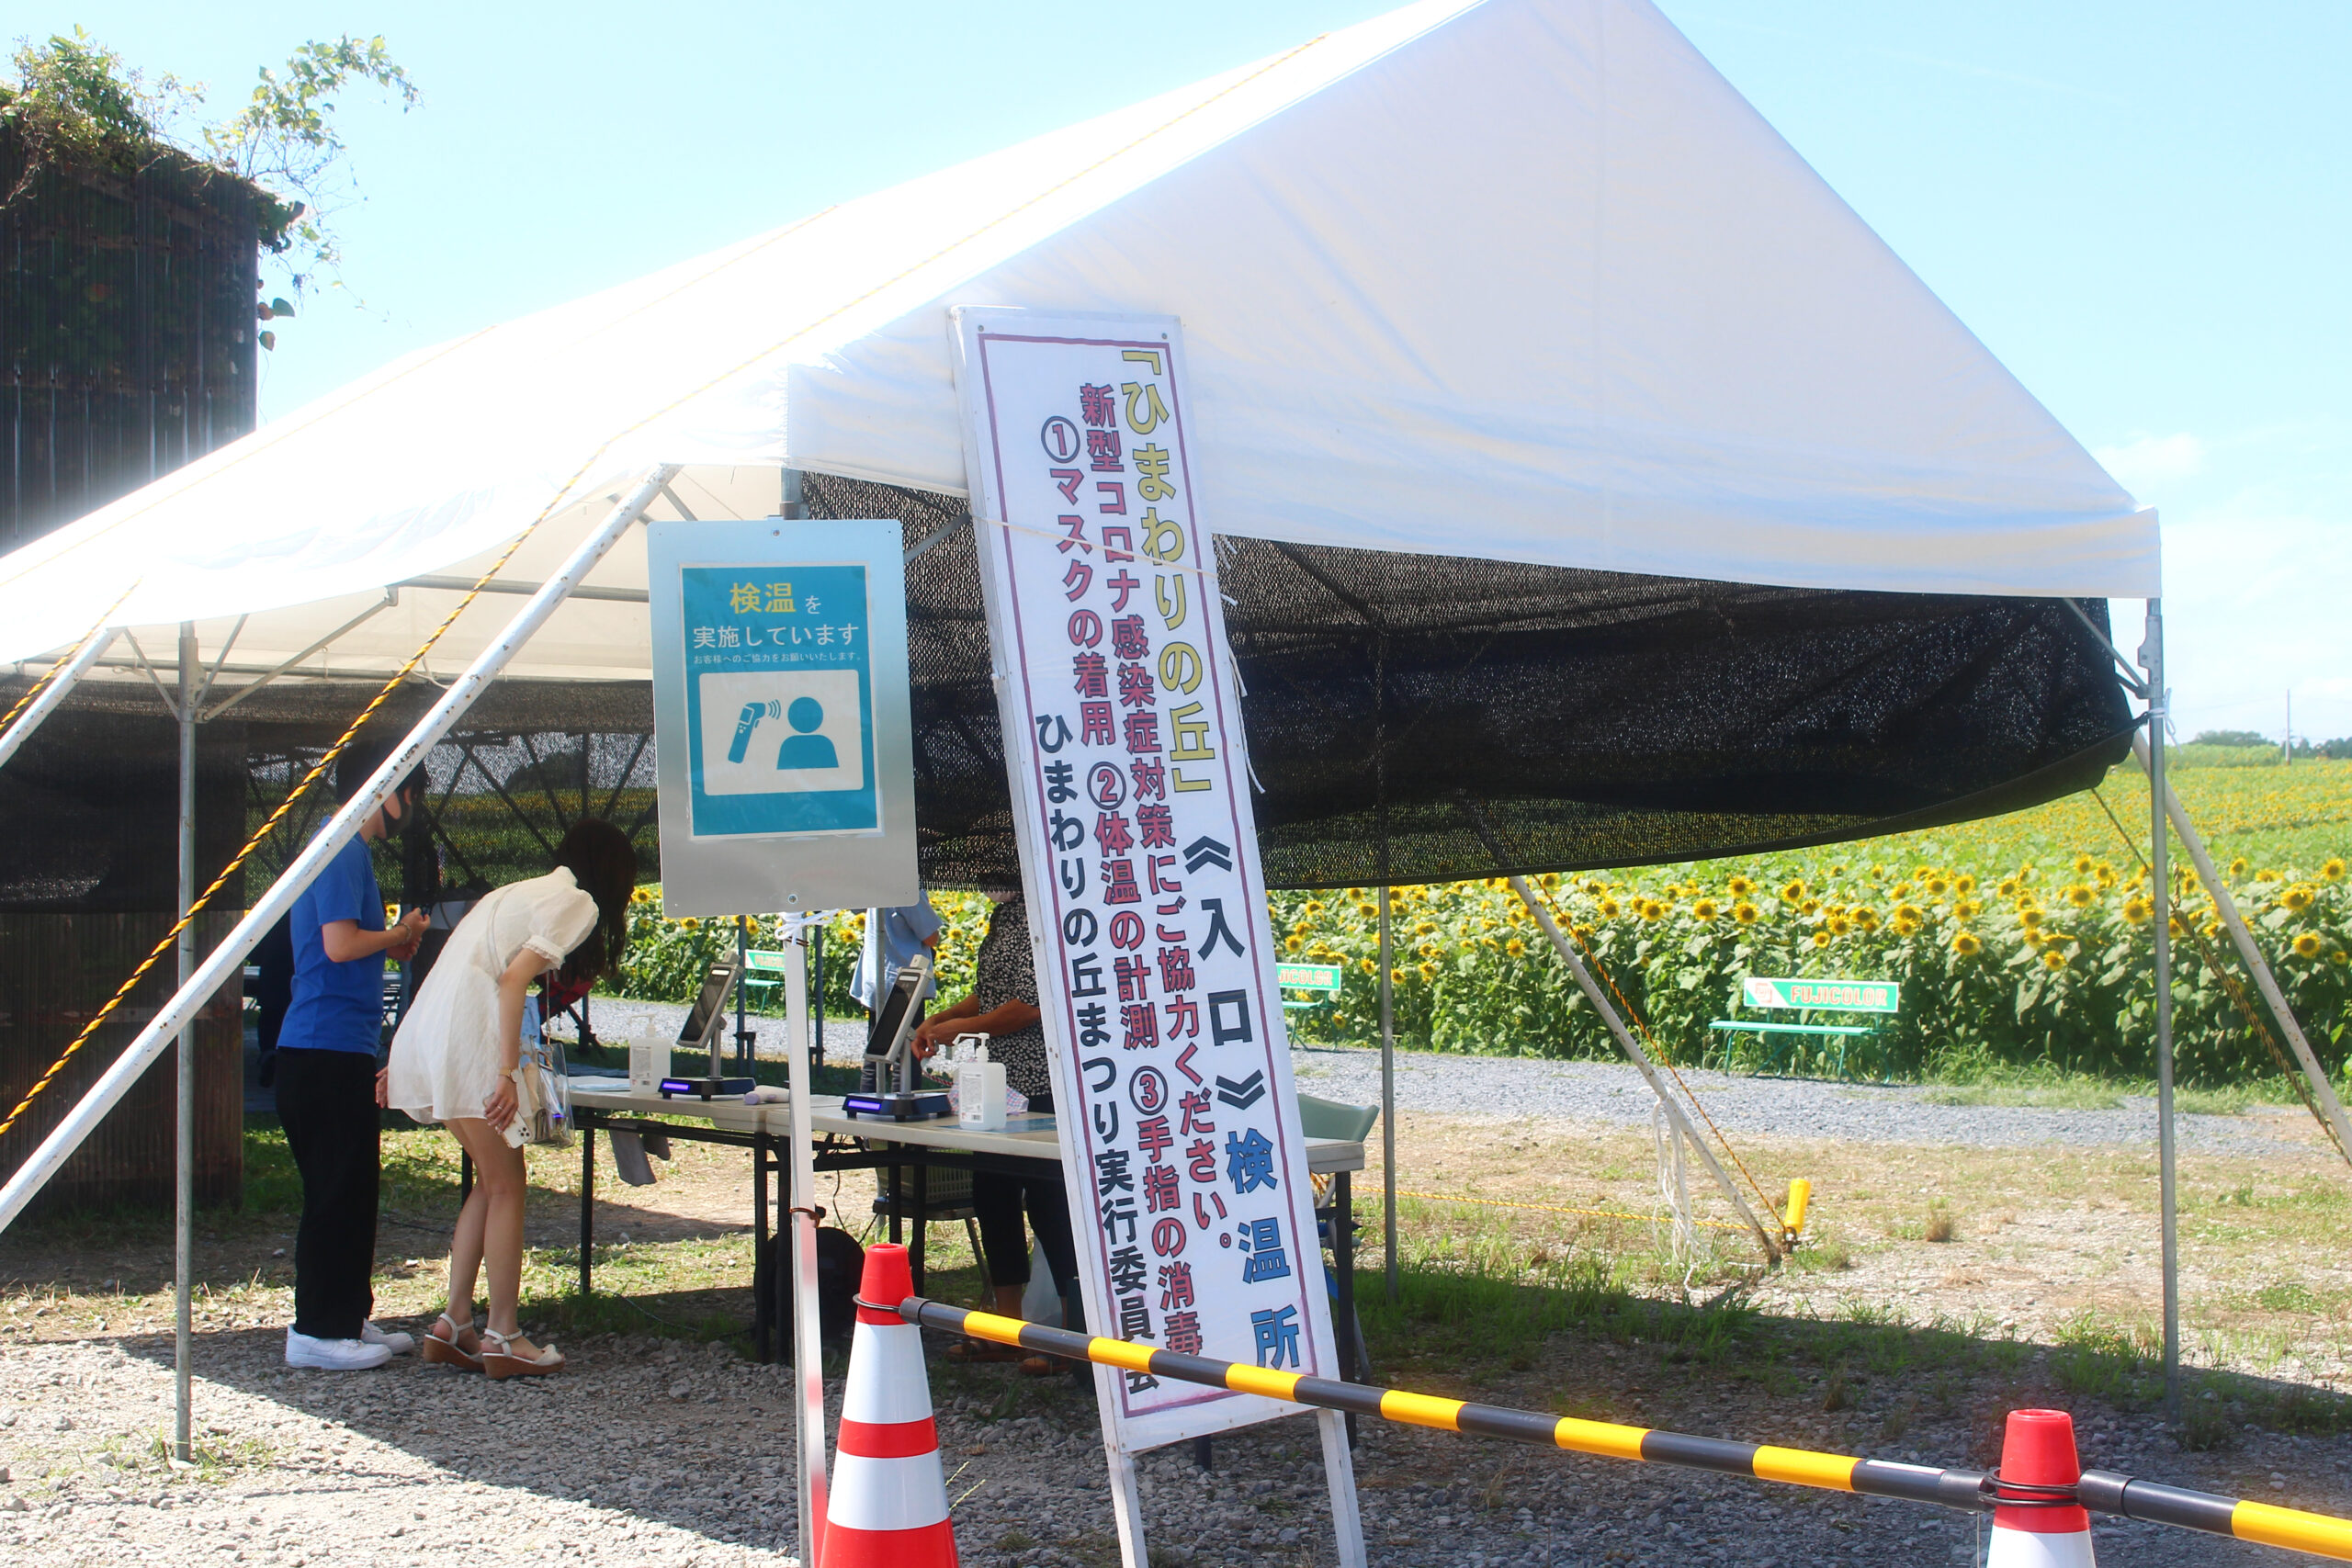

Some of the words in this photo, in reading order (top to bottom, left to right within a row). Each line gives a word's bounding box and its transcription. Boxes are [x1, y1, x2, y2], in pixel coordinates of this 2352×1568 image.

[693, 623, 860, 649] 実施しています
[694, 652, 860, 665] お客様へのご協力をお願いいたします。
[1080, 383, 1231, 1249] 新型コロナ感染症対策にご協力ください。
[1122, 350, 1216, 793] 『ひまわりの丘』
[1226, 1128, 1299, 1370] 検温所
[1041, 416, 1117, 747] ①マスクの着用
[1087, 761, 1159, 1050] ②体温の計測
[1129, 1066, 1204, 1357] ③手指の消毒
[1278, 969, 1333, 986] JICOLOR
[1791, 986, 1888, 1007] FUJICOLOR
